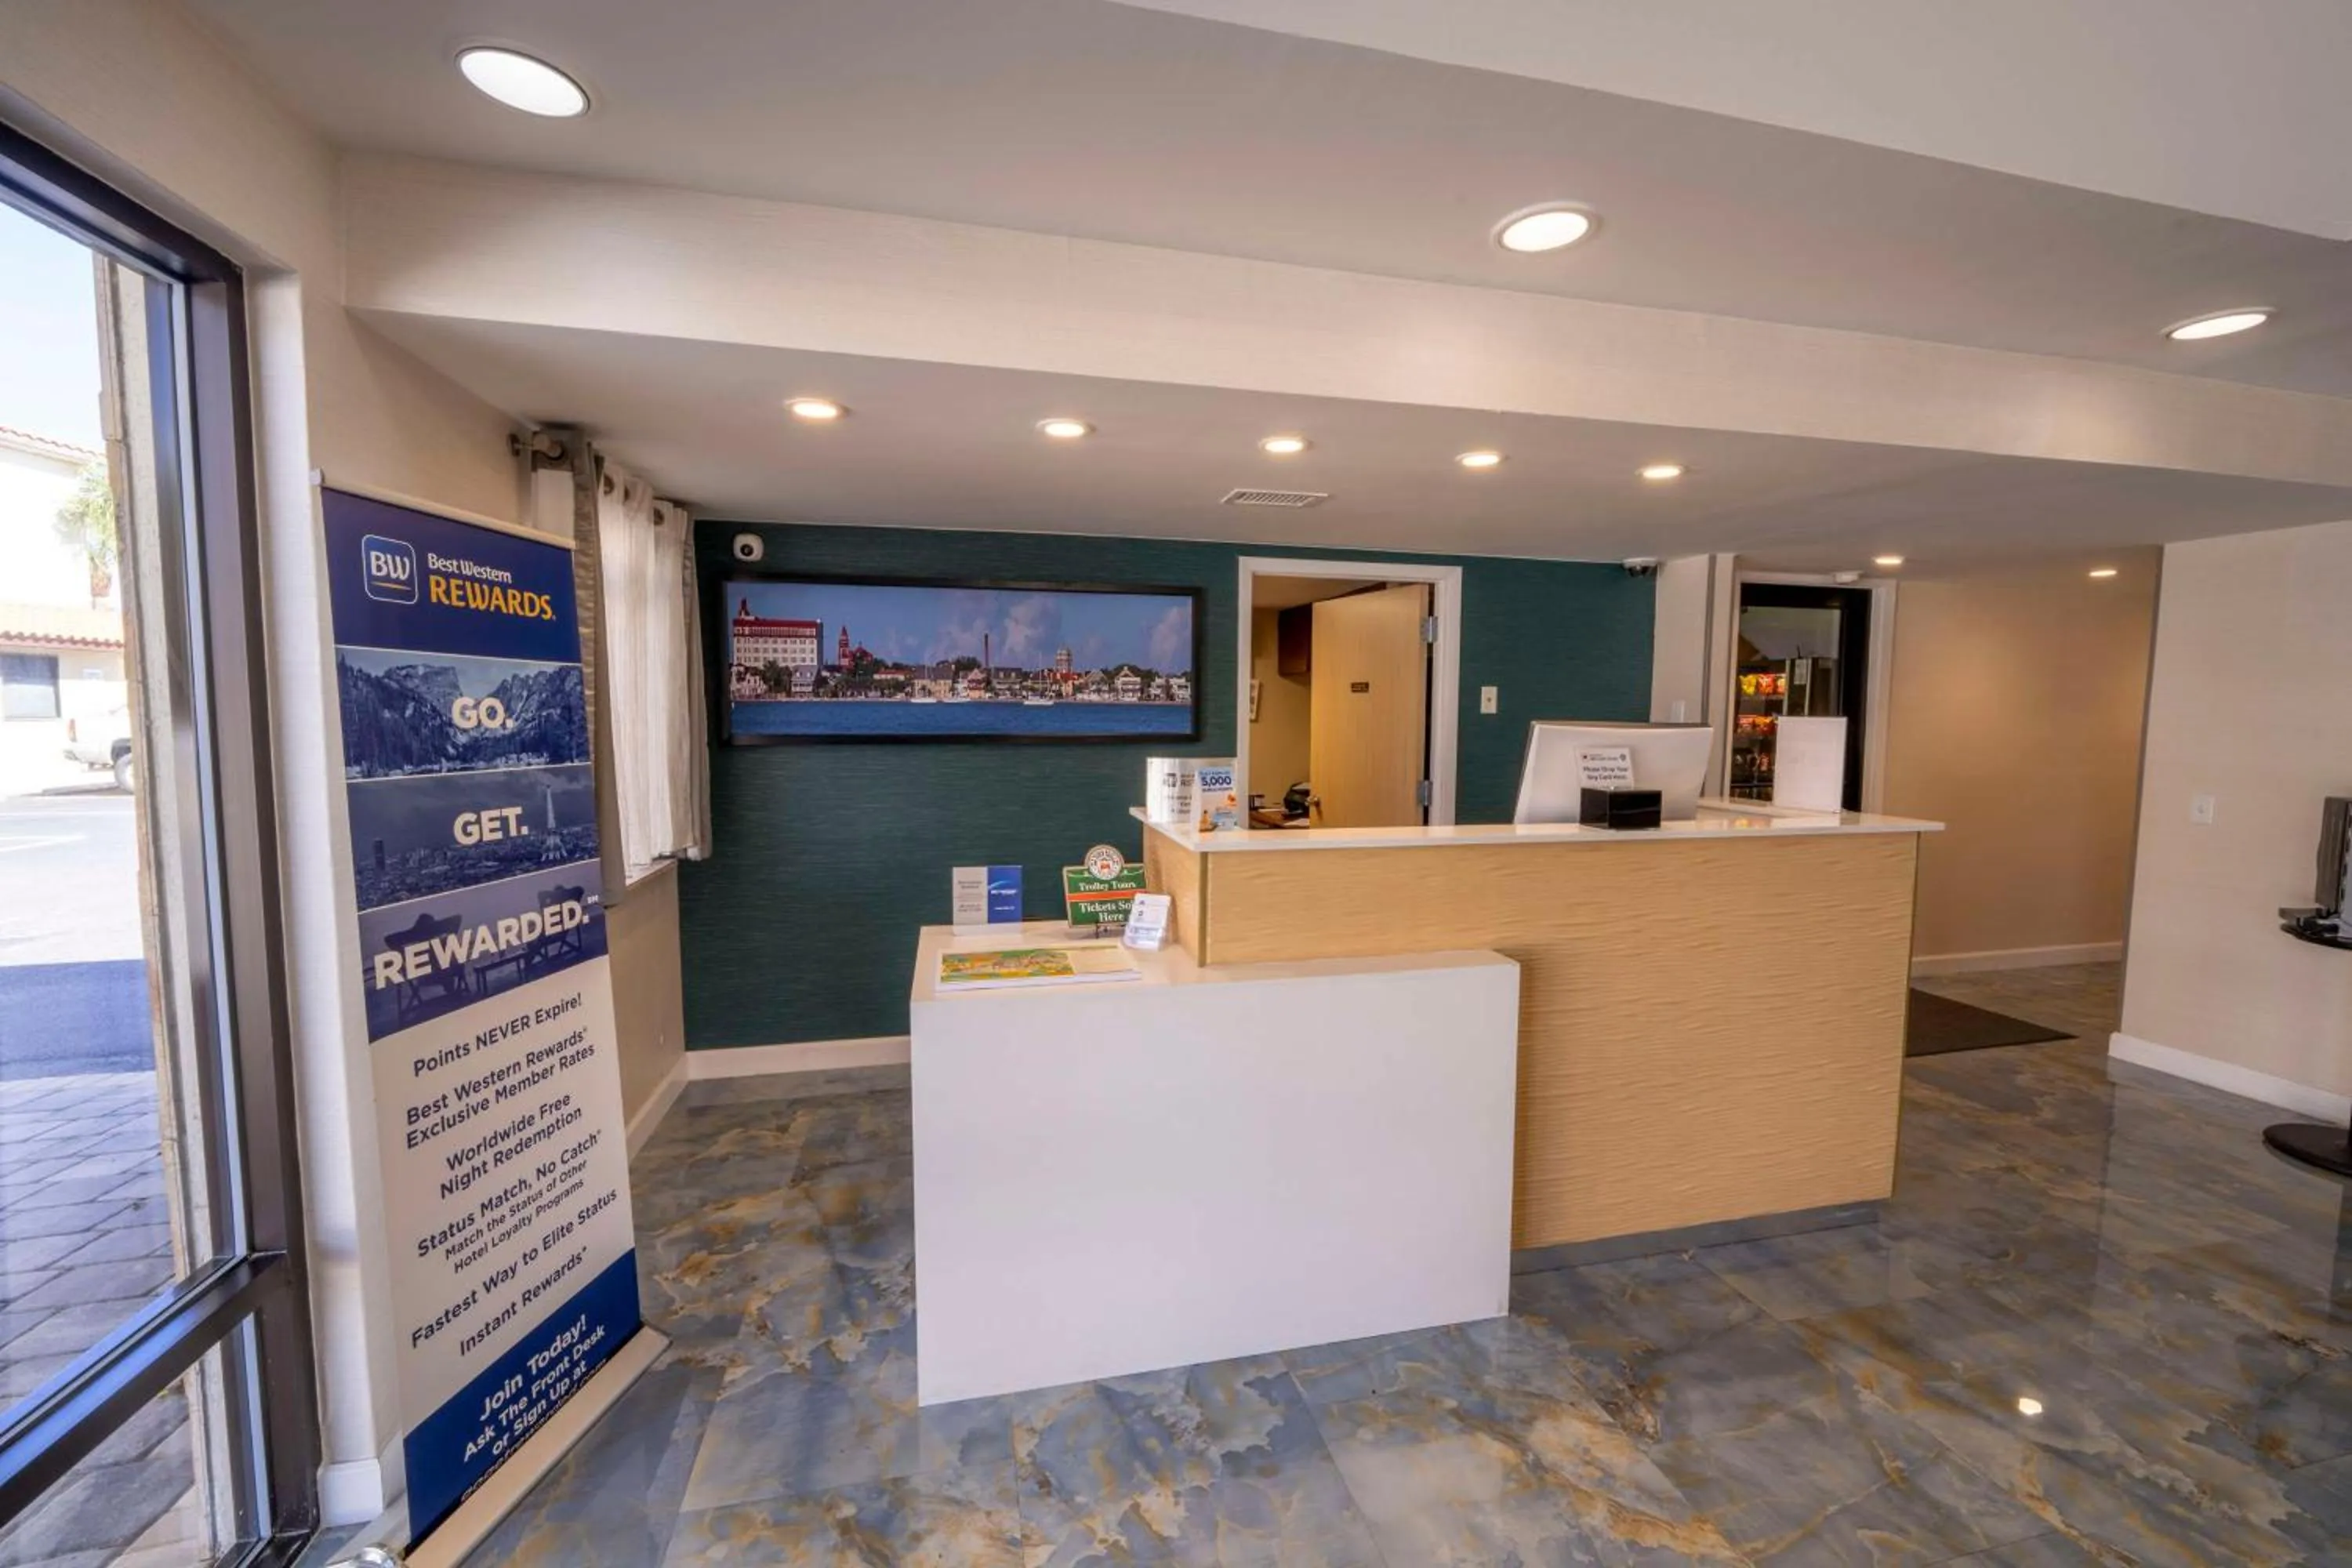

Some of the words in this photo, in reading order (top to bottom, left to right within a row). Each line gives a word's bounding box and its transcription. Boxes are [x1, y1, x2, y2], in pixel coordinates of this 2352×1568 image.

[369, 550, 411, 580] BW
[427, 552, 459, 574] Best
[460, 559, 513, 584] Western
[451, 696, 514, 728] GO.
[1200, 775, 1232, 787] 5,000
[453, 806, 528, 845] GET.
[1079, 882, 1109, 891] Trolley
[1111, 880, 1136, 890] Tours
[1079, 902, 1116, 913] Tickets
[1098, 912, 1125, 922] Here
[413, 1040, 470, 1077] Points
[475, 1014, 530, 1051] NEVER
[534, 993, 583, 1023] Expire!
[406, 1098, 490, 1149] Exclusive
[495, 1063, 555, 1104] Member
[558, 1044, 595, 1073] Rates
[407, 1093, 449, 1126] Best
[454, 1061, 521, 1102] Western
[440, 1161, 488, 1200] Night
[493, 1107, 582, 1168] Redemption
[446, 1113, 535, 1171] Worldwide
[539, 1094, 571, 1120] Free
[417, 1213, 475, 1258] Status
[480, 1178, 532, 1218] Match,
[535, 1161, 556, 1181] No
[445, 1229, 484, 1261] Match
[487, 1215, 506, 1232] the
[509, 1190, 543, 1218] Status
[546, 1179, 557, 1192] of
[559, 1160, 587, 1183] Other
[453, 1241, 488, 1274] Hotel
[492, 1214, 532, 1248] Loyalty
[535, 1178, 584, 1218] Programs
[411, 1290, 478, 1348] Fastest
[483, 1261, 518, 1294] Way
[522, 1247, 539, 1266] to
[542, 1220, 574, 1252] Elite
[577, 1188, 618, 1225] Status
[459, 1301, 517, 1356] Instant
[463, 1424, 495, 1463] Ask
[498, 1396, 528, 1427] The
[531, 1356, 572, 1399] Front
[572, 1325, 606, 1361] Desk
[480, 1374, 523, 1421] Join
[527, 1314, 587, 1375] Today!
[492, 1432, 510, 1456] or
[514, 1398, 547, 1436] Sign
[550, 1378, 571, 1401] Up
[573, 1360, 588, 1381] at
